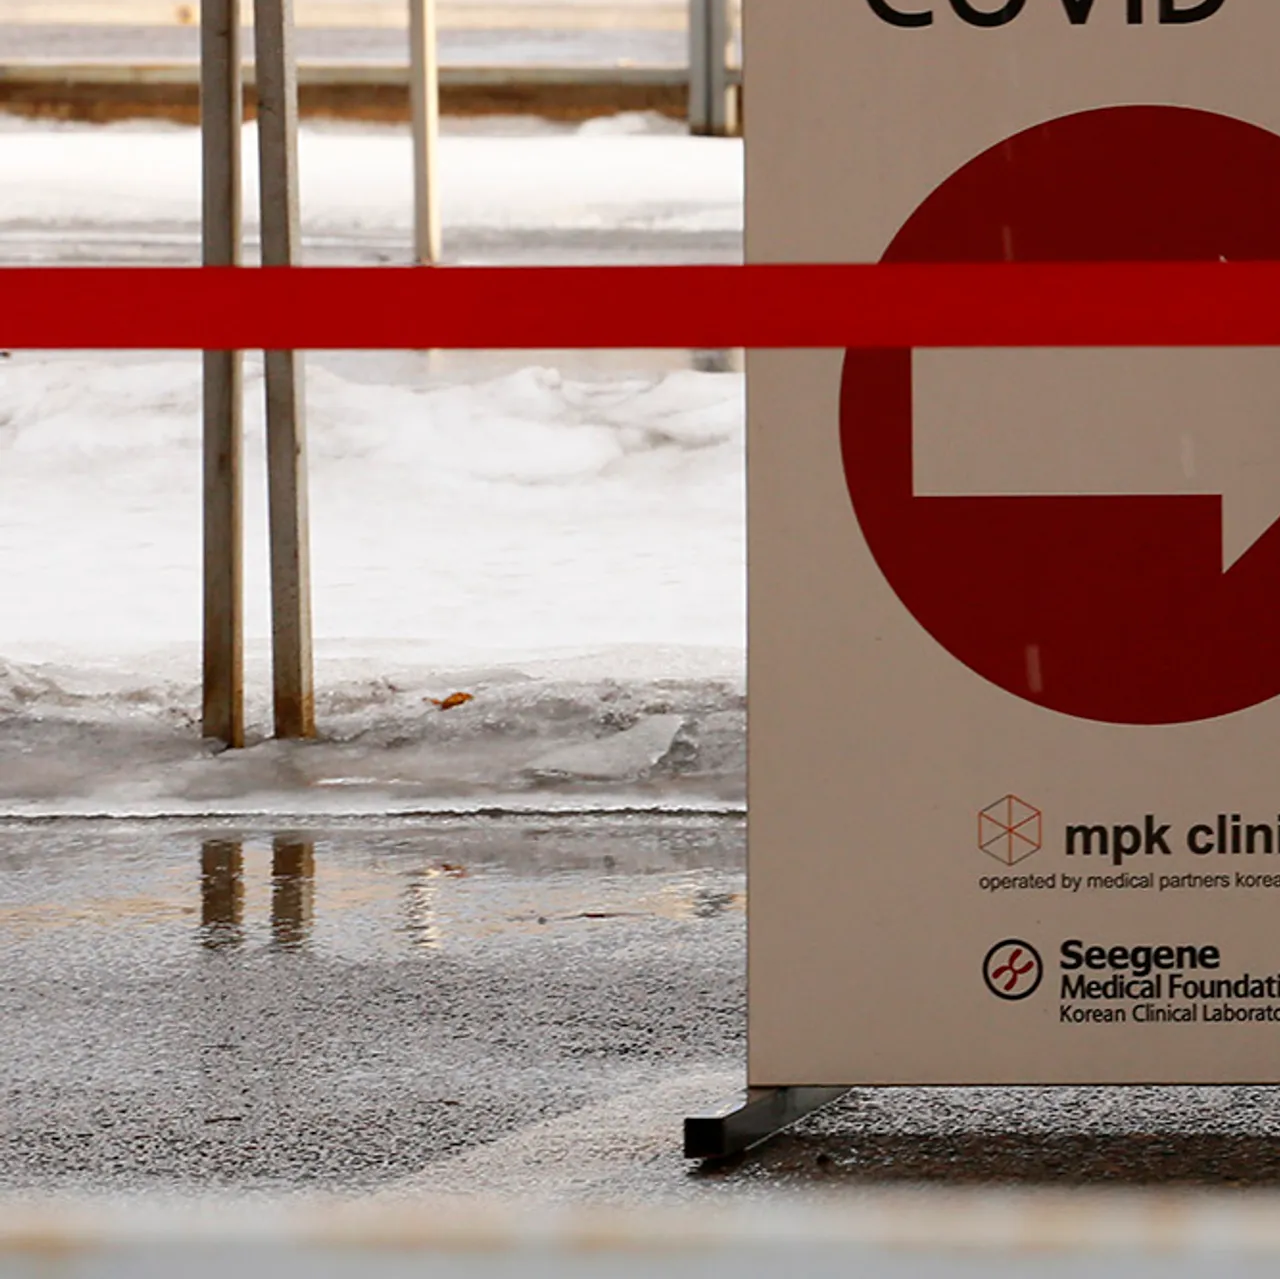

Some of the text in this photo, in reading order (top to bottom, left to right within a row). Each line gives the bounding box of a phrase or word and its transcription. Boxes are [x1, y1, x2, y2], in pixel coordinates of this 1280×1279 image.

[1066, 814, 1171, 866] mpk
[979, 873, 1056, 893] operated
[1061, 873, 1082, 893] by
[1087, 872, 1154, 889] medical
[1159, 873, 1231, 892] partners
[1060, 940, 1220, 976] Seegene
[1061, 973, 1161, 999] Medical
[1060, 1004, 1126, 1023] Korean
[1132, 1003, 1197, 1023] Clinical
